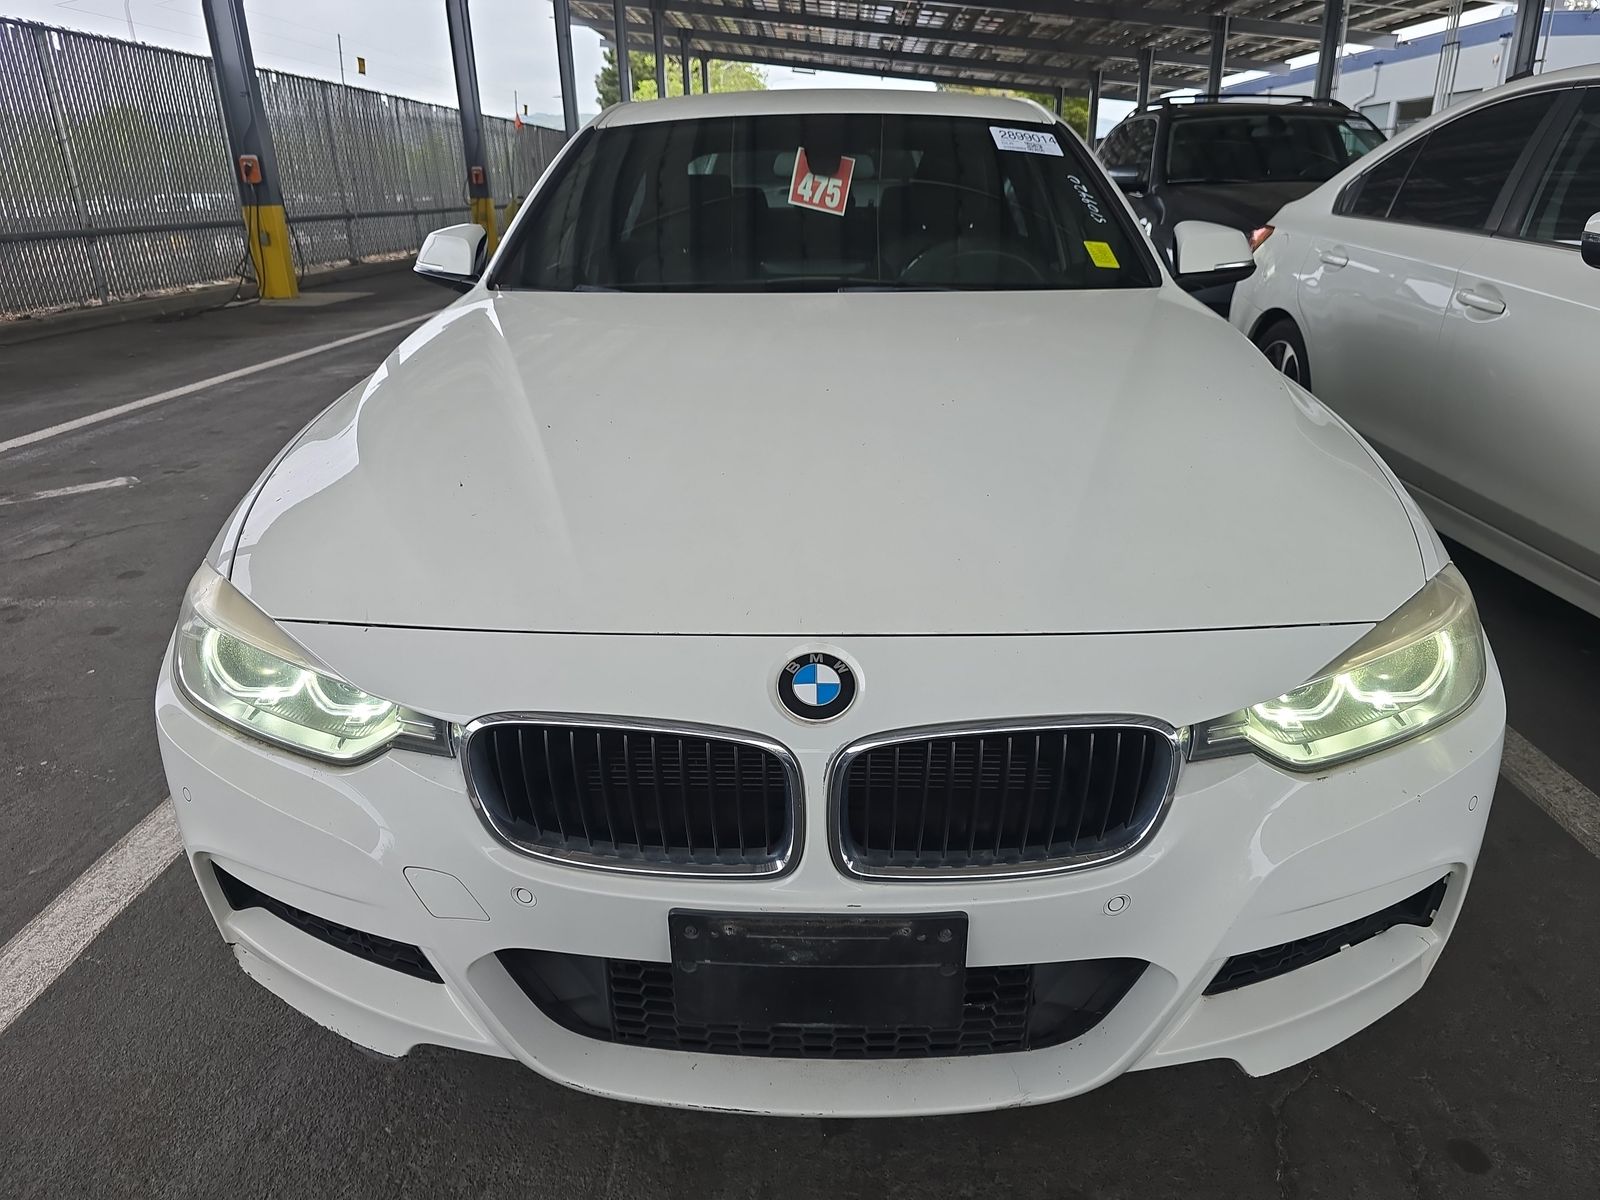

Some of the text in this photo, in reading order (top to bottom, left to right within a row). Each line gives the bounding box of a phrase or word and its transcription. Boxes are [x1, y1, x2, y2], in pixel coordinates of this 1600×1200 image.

[999, 130, 1057, 144] 2899014
[797, 172, 843, 208] 475
[785, 653, 849, 674] BMW
